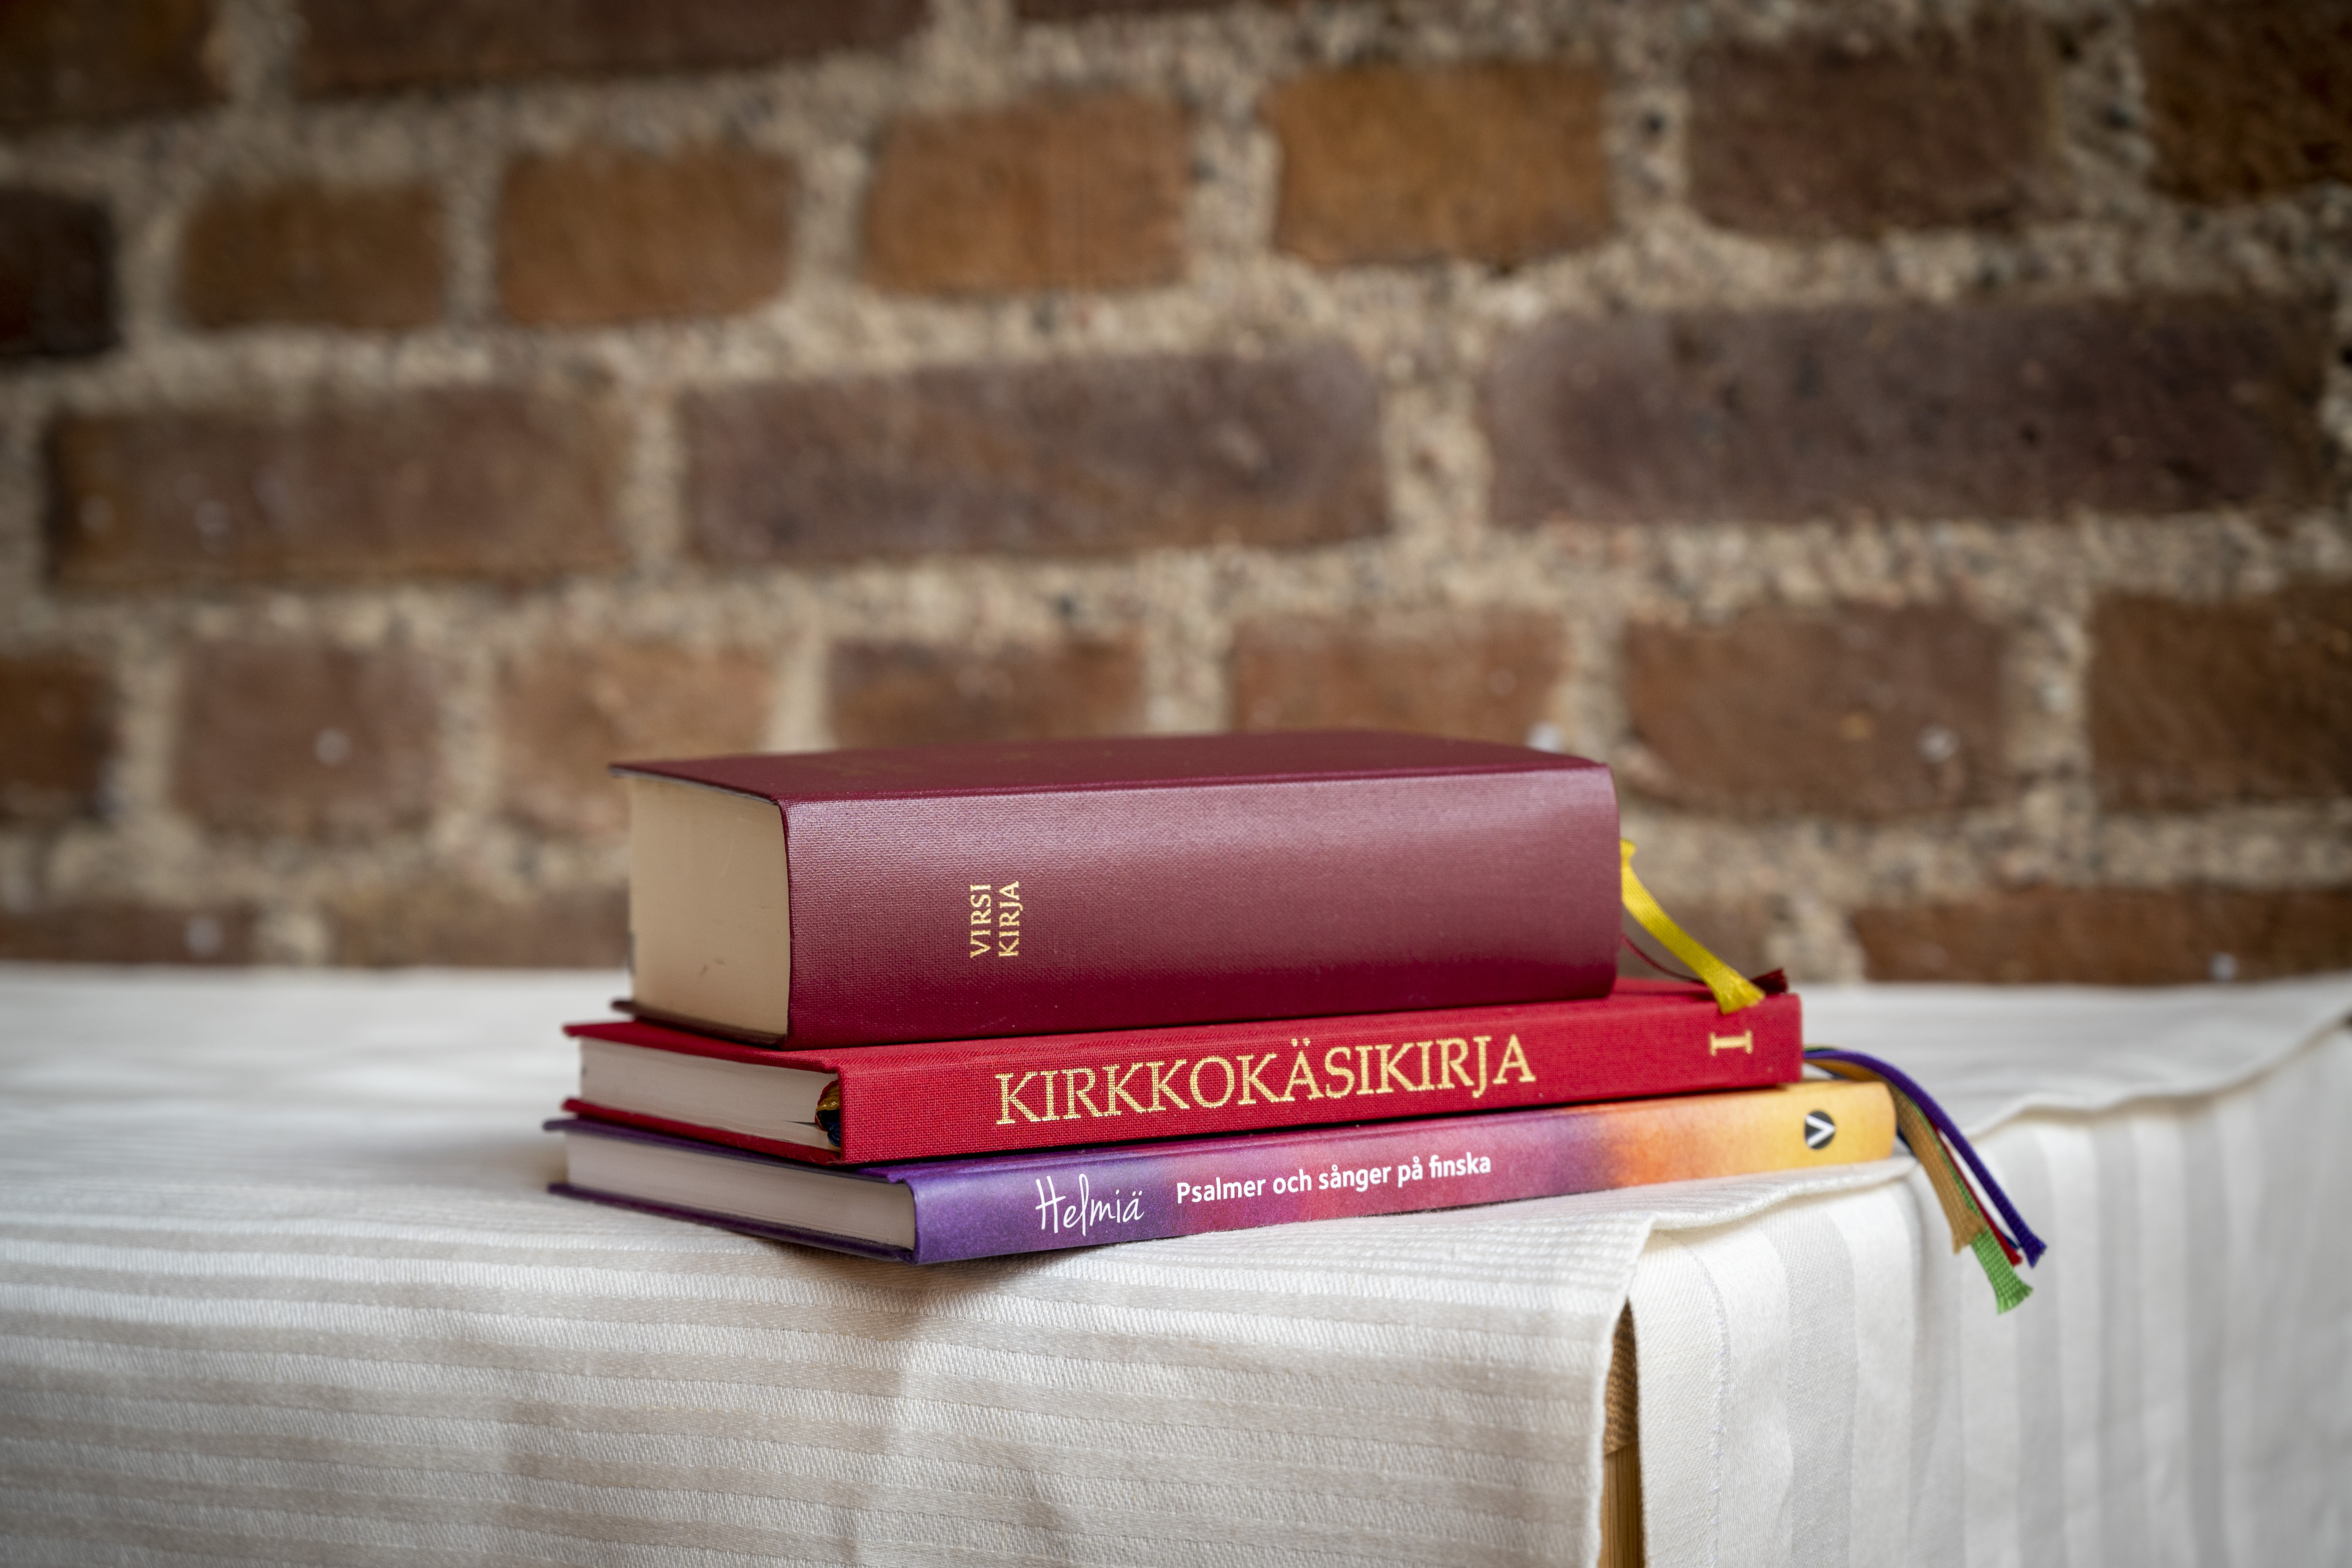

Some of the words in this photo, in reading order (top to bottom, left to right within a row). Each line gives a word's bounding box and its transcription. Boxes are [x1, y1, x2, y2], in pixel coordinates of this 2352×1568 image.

[969, 884, 992, 958] VIRSI
[998, 880, 1023, 957] KIRJA
[994, 1033, 1537, 1125] KIRKKOKÄSIKIRJA
[1035, 1173, 1145, 1236] Helmiä
[1177, 1177, 1266, 1205] Psalmer
[1273, 1168, 1312, 1194] och
[1318, 1164, 1392, 1192] sånger
[1397, 1155, 1424, 1188] på
[1428, 1151, 1492, 1178] finska
